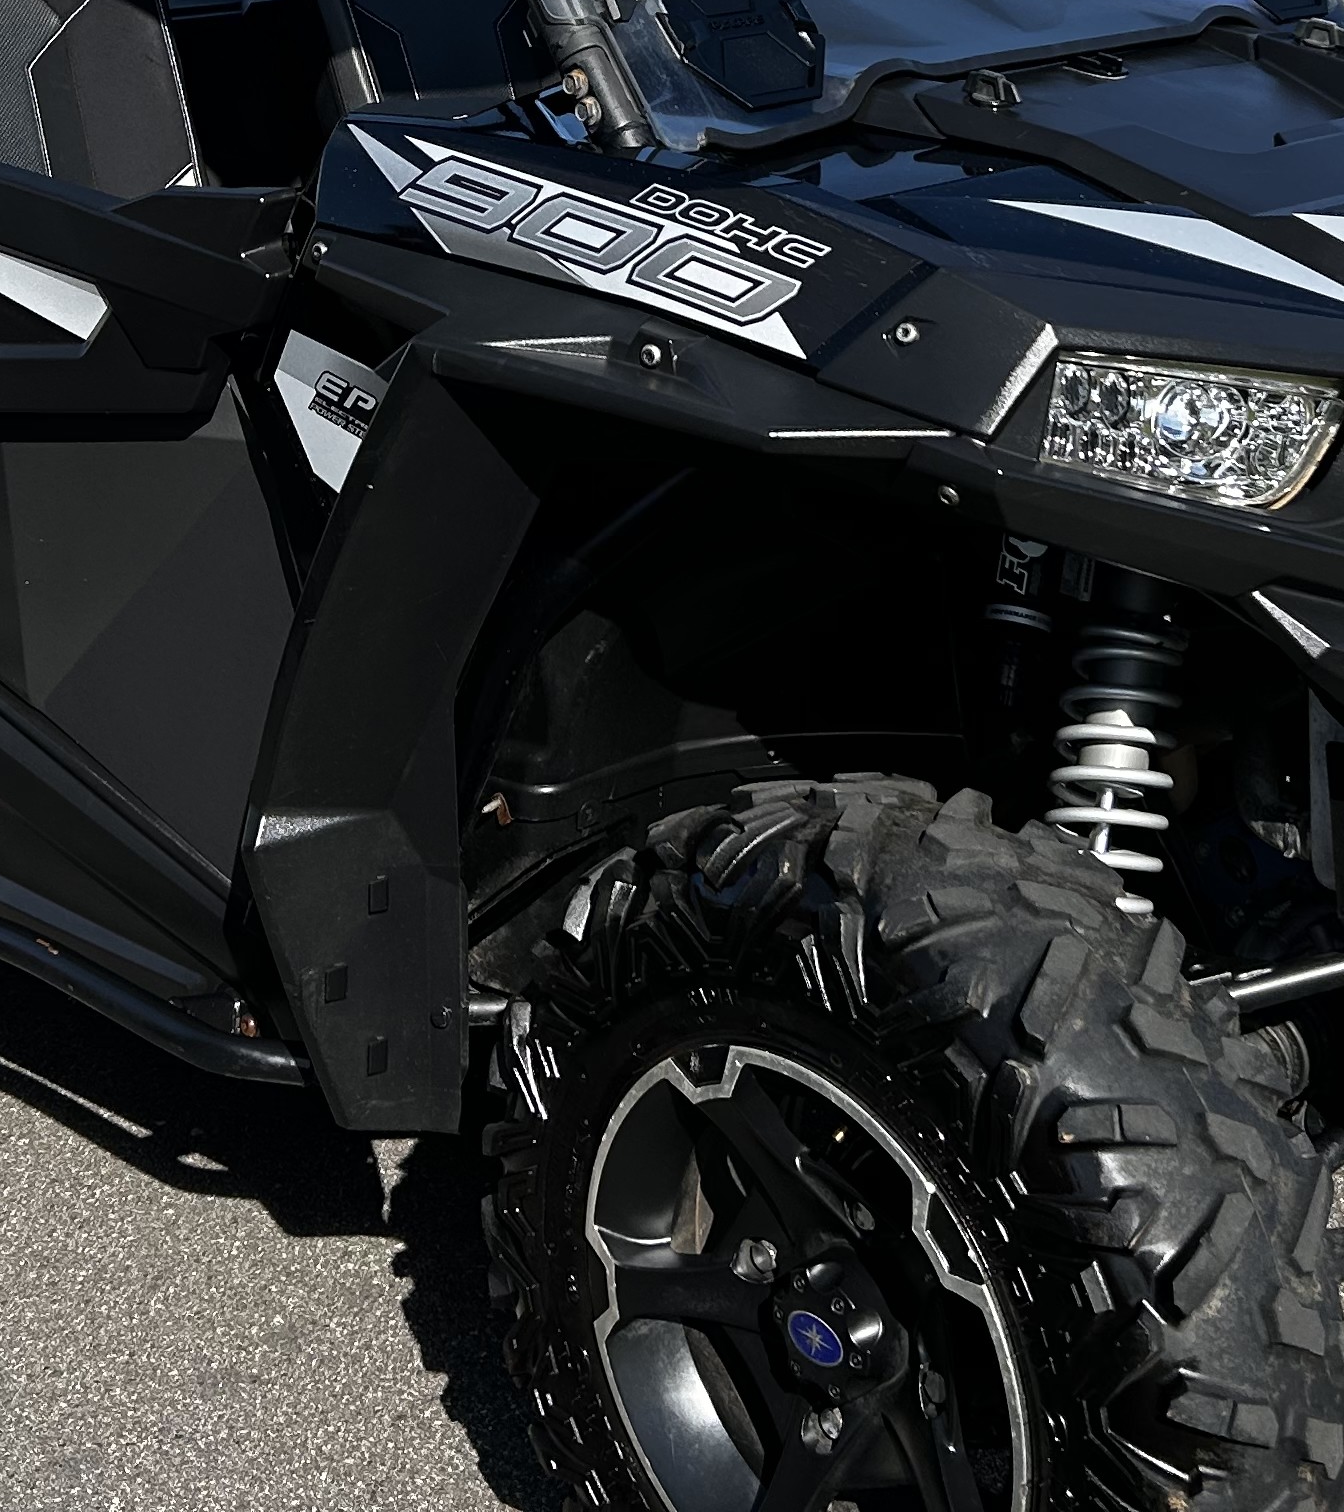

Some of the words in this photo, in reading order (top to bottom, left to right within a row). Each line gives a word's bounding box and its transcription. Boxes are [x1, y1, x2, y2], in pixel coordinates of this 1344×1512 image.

[398, 154, 804, 327] 900
[628, 183, 833, 270] DOHC
[309, 402, 347, 427] POWER
[315, 371, 377, 411] EP
